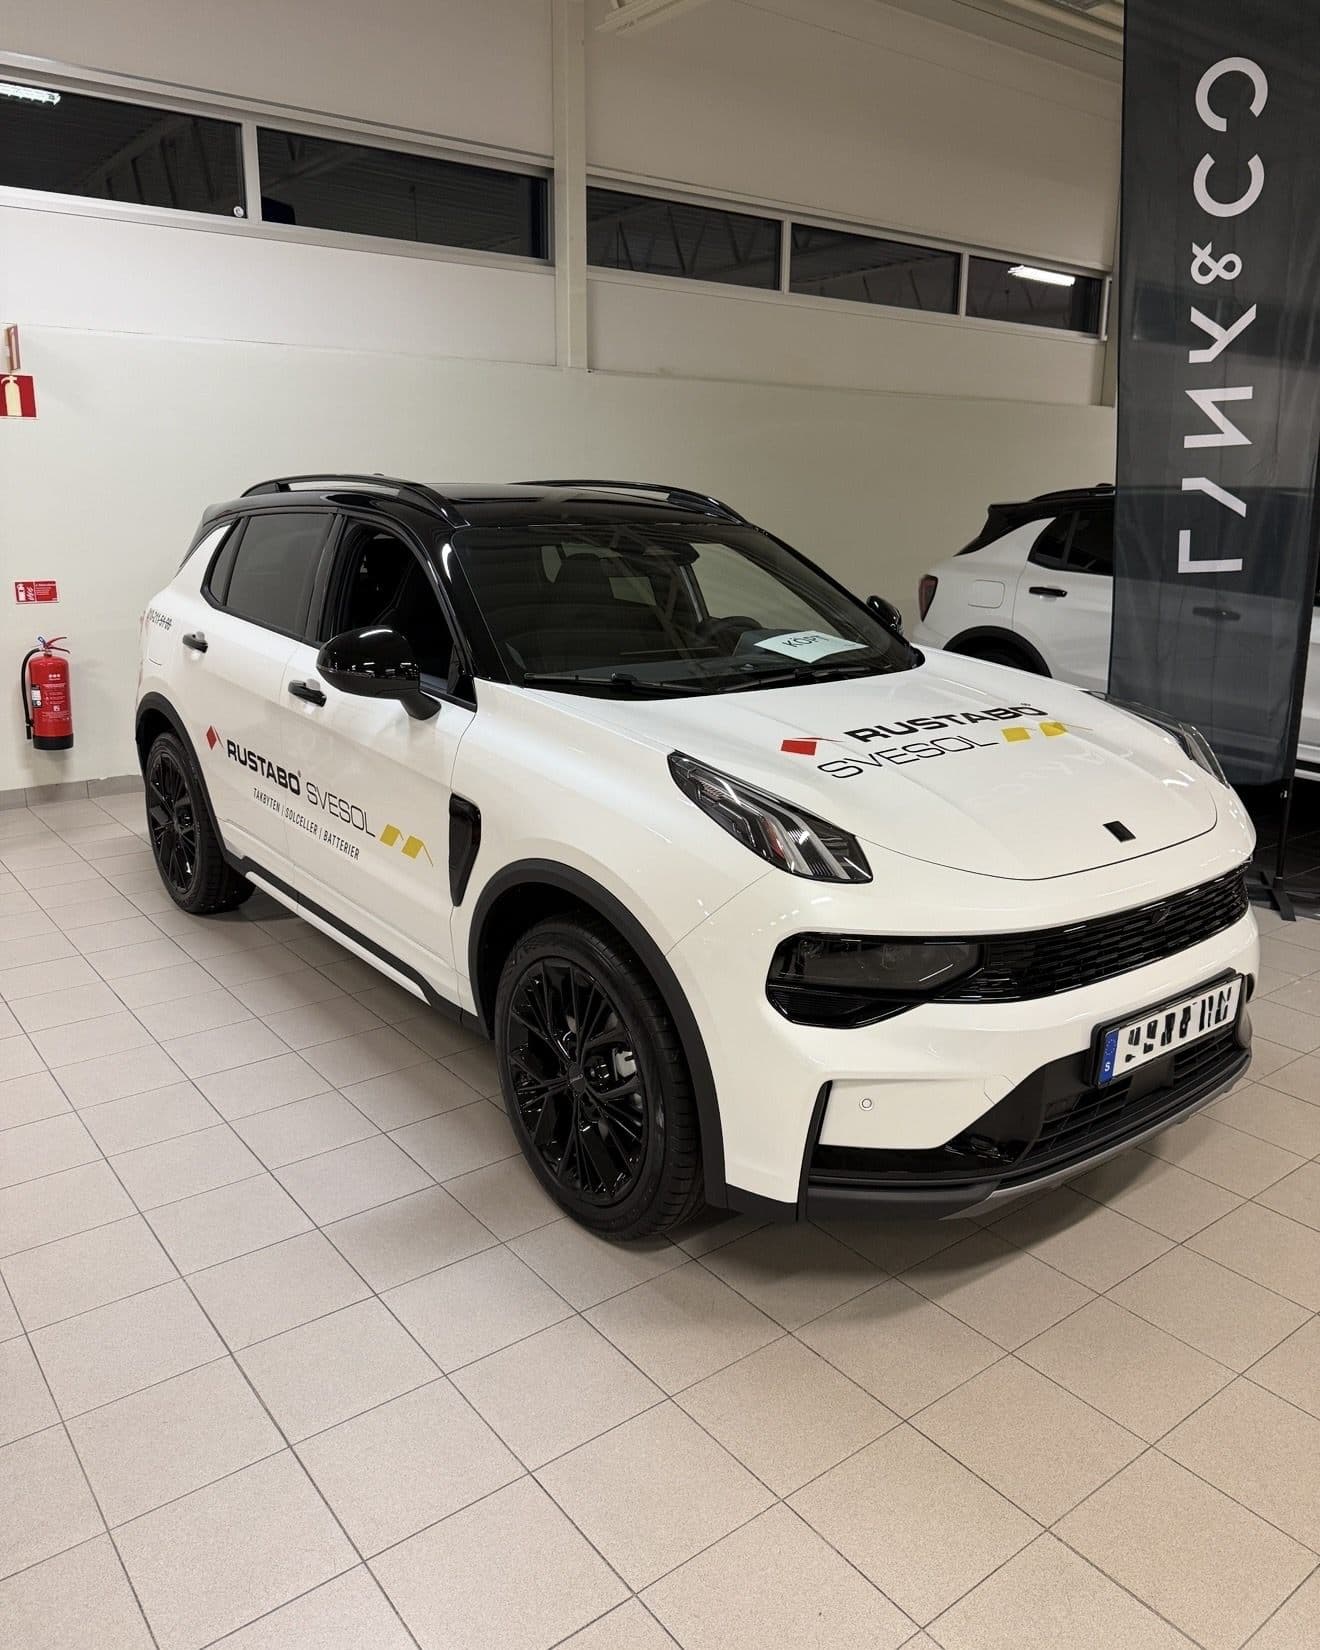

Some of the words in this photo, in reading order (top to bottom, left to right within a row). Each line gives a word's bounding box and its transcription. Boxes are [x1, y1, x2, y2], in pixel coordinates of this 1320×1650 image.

[817, 735, 999, 779] SVESOL
[253, 787, 280, 811] TAKBYTEN
[285, 807, 318, 836] SOLCELLER
[323, 830, 360, 861] BATTERIER
[306, 782, 376, 837] SVESOL
